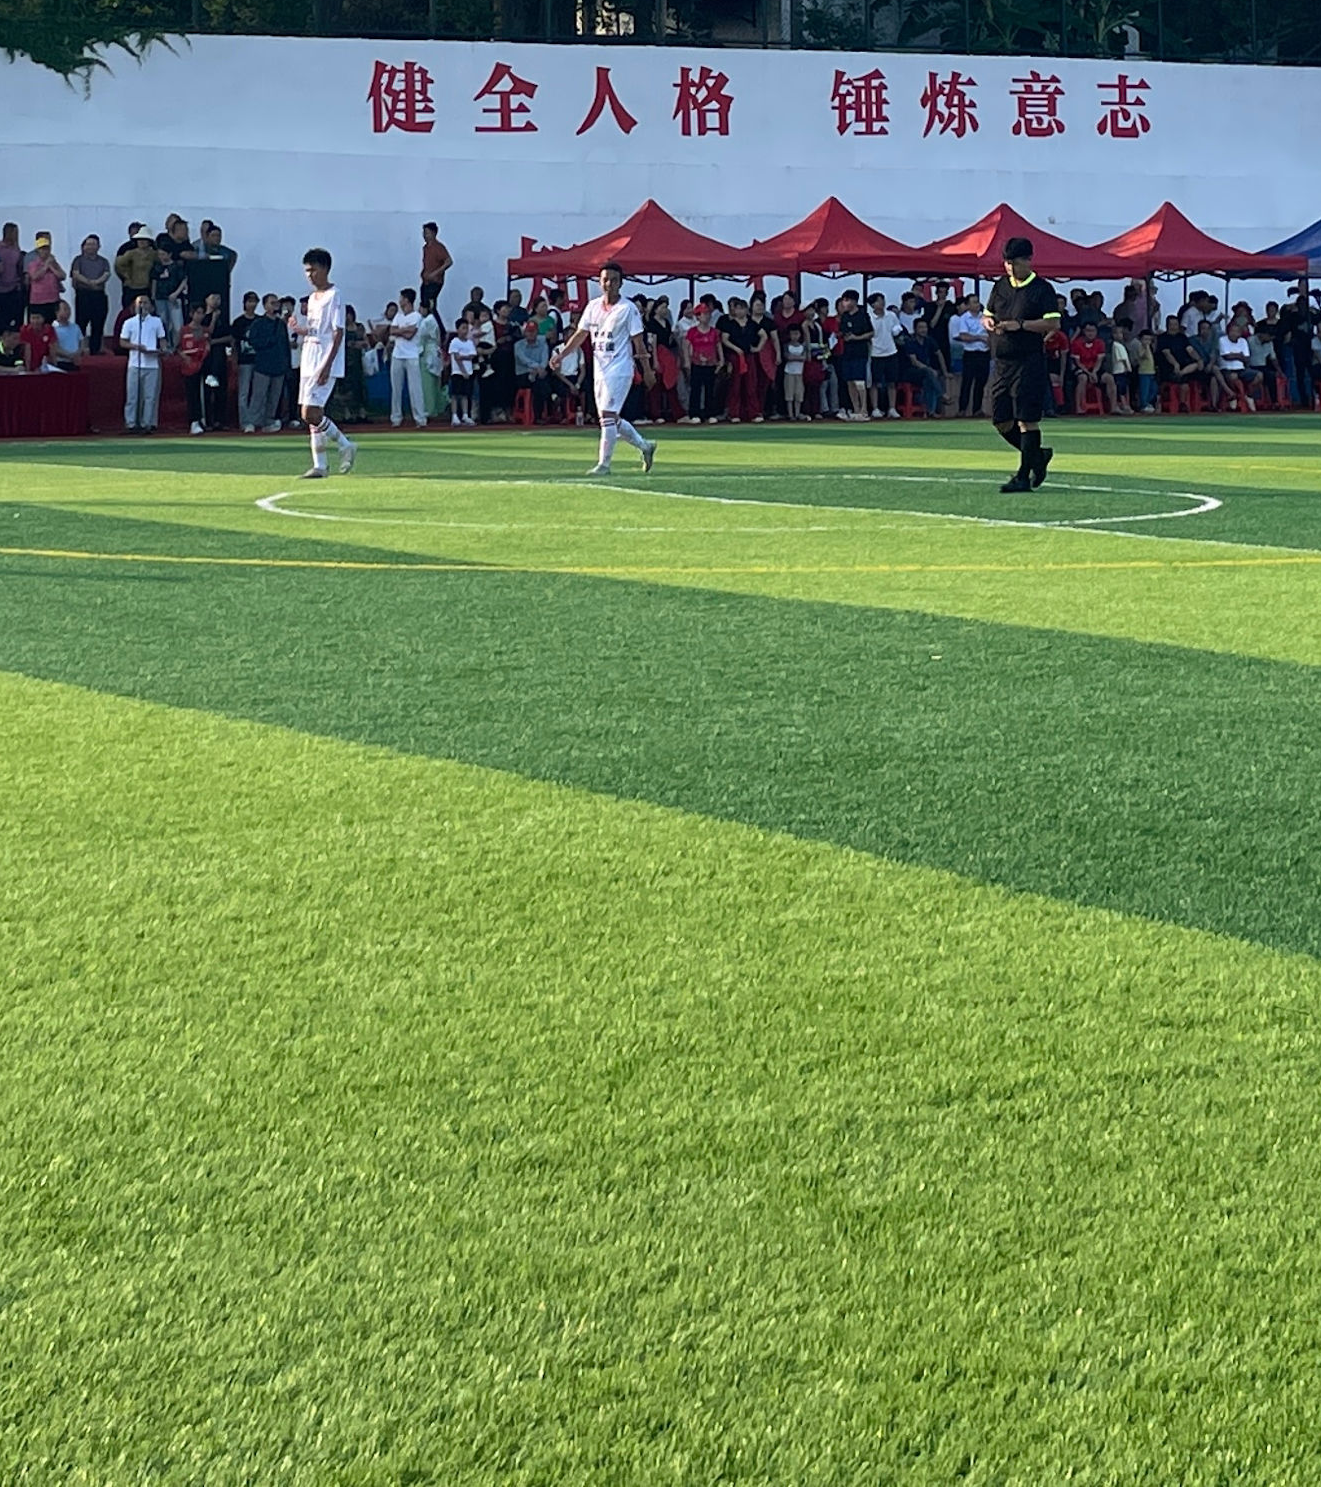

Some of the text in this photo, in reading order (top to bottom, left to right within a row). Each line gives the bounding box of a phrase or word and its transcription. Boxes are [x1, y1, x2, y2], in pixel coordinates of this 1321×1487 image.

[367, 60, 1151, 139] 健全人格 锤炼意志
